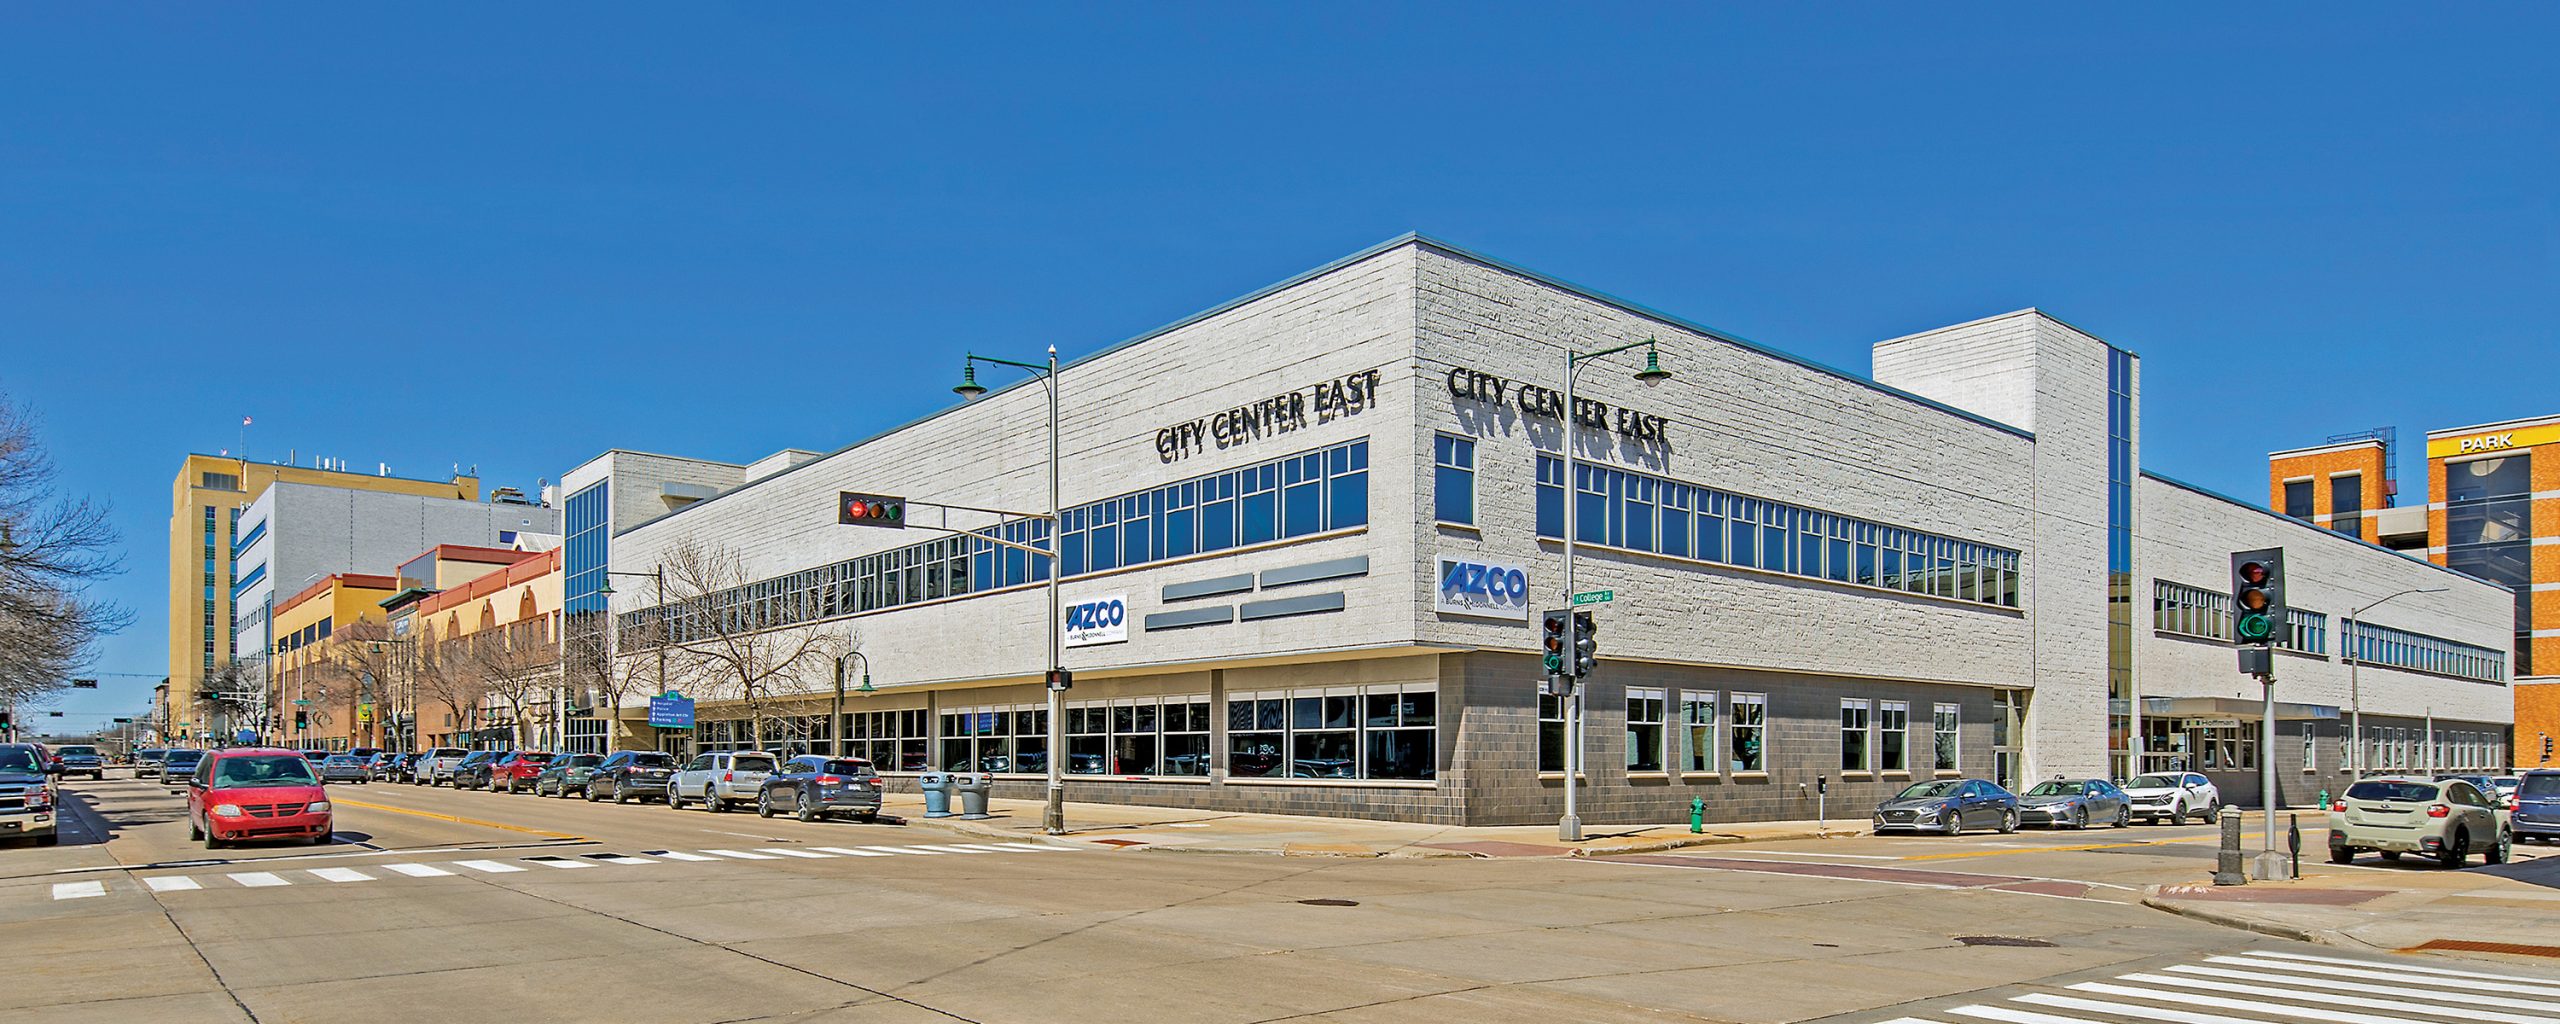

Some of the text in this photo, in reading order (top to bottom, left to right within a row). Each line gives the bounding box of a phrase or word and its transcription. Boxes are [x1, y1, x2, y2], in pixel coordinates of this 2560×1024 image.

[1156, 369, 1378, 455] CITY CENTER EAST
[1448, 367, 1668, 443] CITY CENTER EAST
[2460, 433, 2512, 451] PARK
[1441, 562, 1526, 598] AZCO
[1580, 593, 1603, 603] College
[1066, 599, 1124, 632] AZCO
